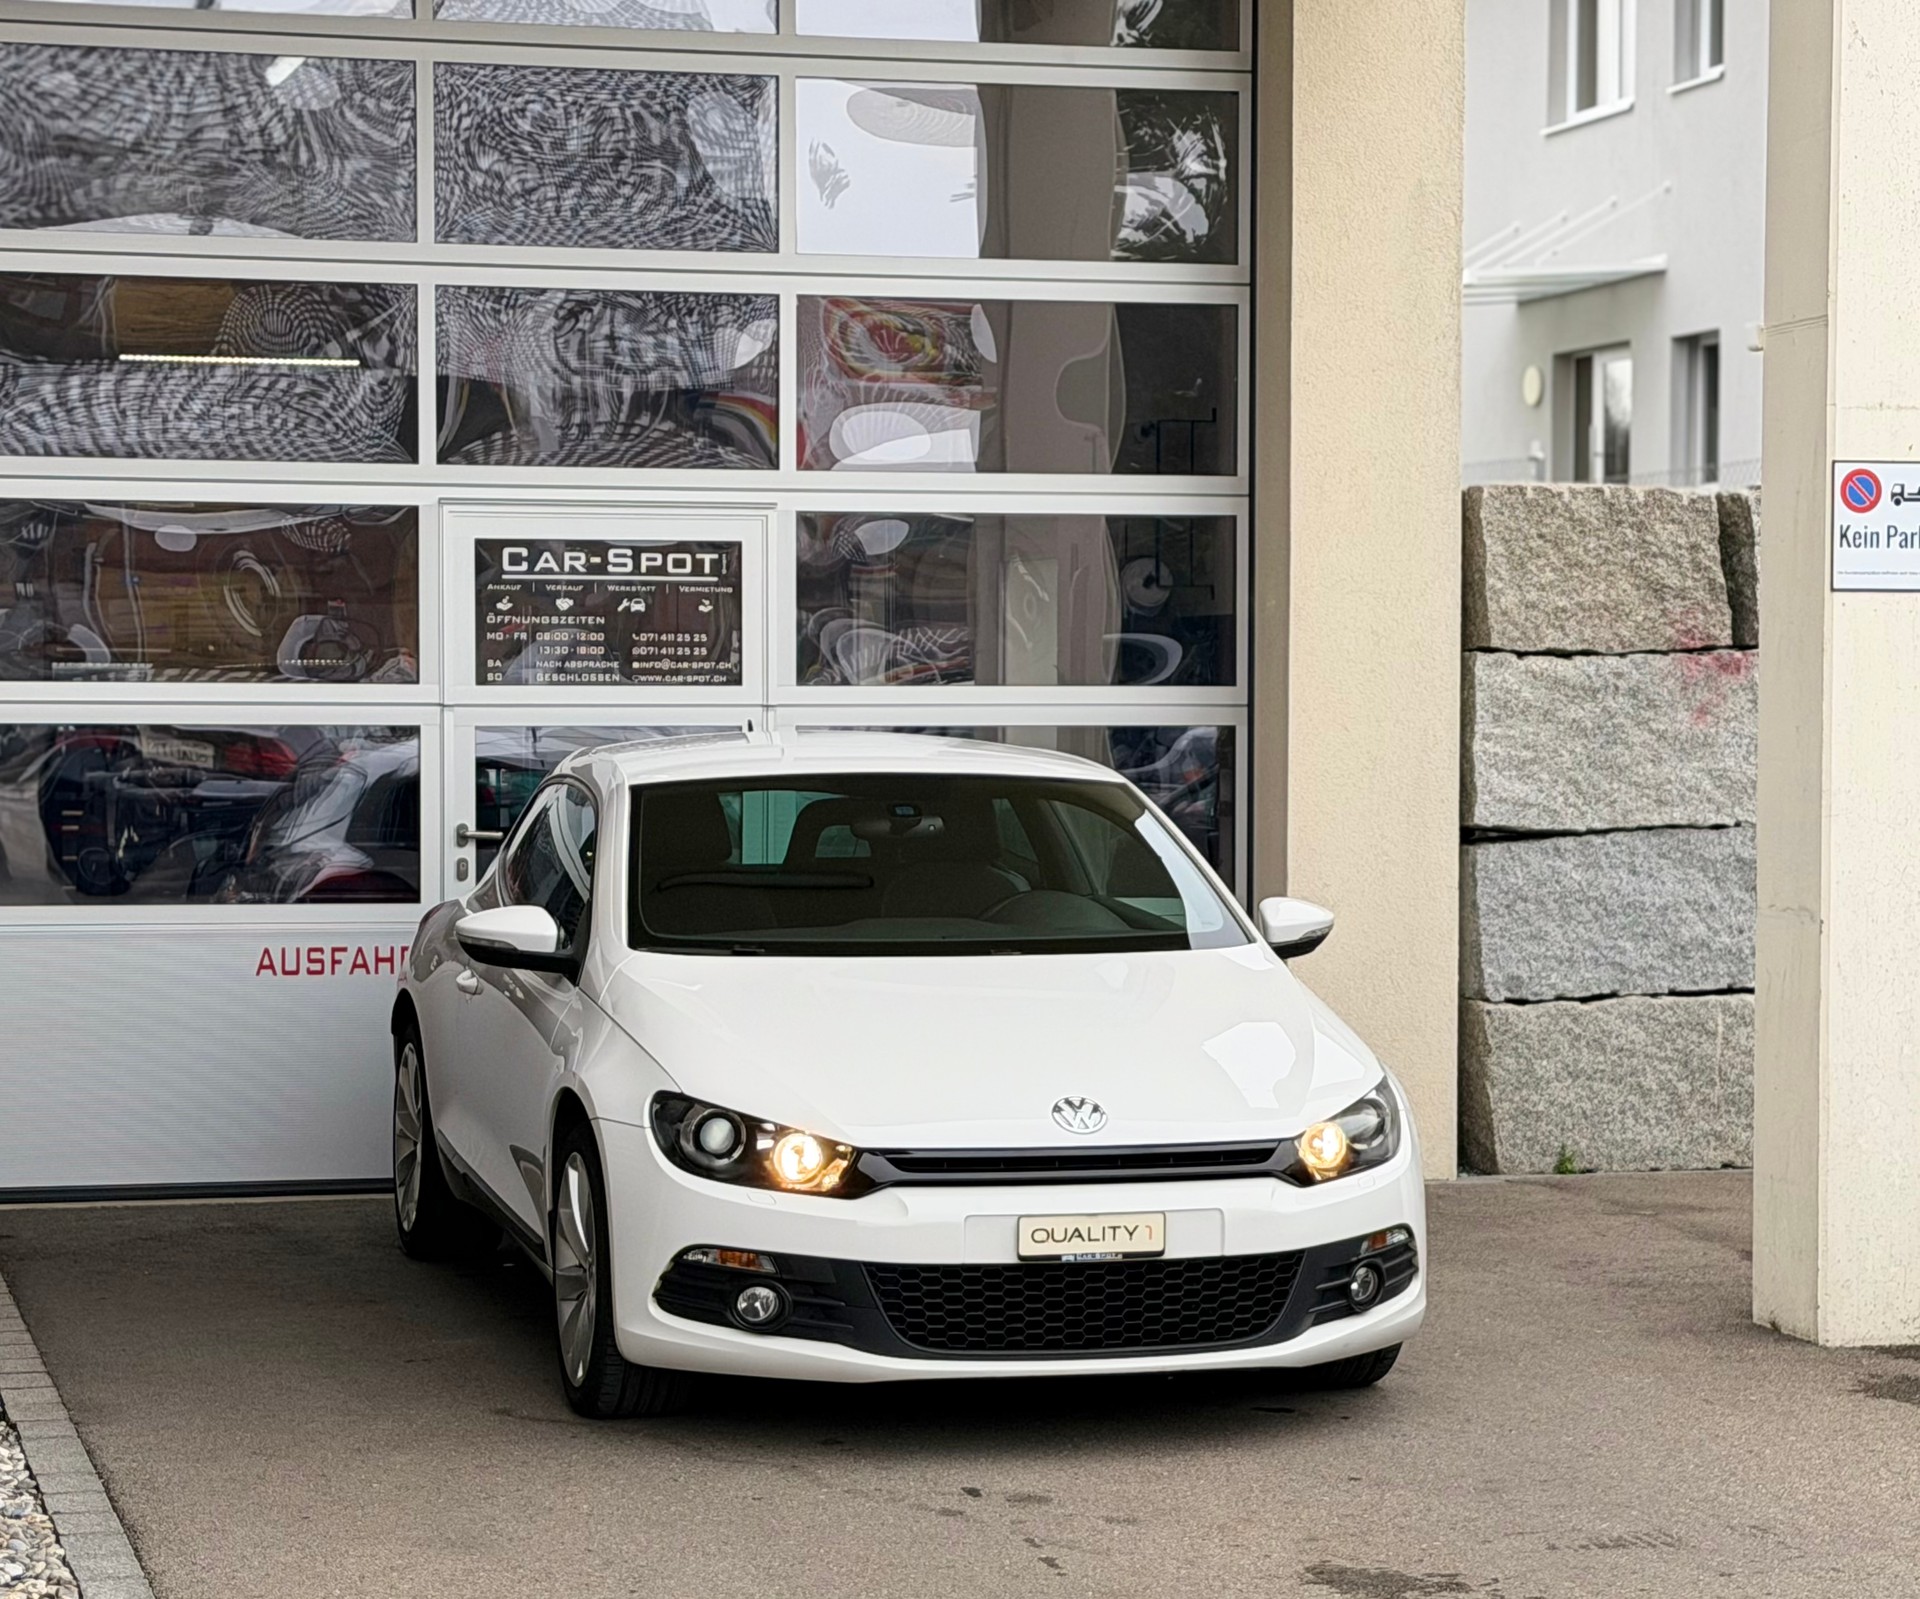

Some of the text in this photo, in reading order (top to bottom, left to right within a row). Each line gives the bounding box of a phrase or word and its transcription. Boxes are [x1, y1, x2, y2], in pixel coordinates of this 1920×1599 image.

[1839, 524, 1920, 549] Kein Par
[486, 612, 605, 624] ÖFFNUNGSZEITEN
[513, 632, 528, 640] FR
[1052, 1095, 1108, 1134] VW
[1030, 1224, 1153, 1245] QUALITY 1
